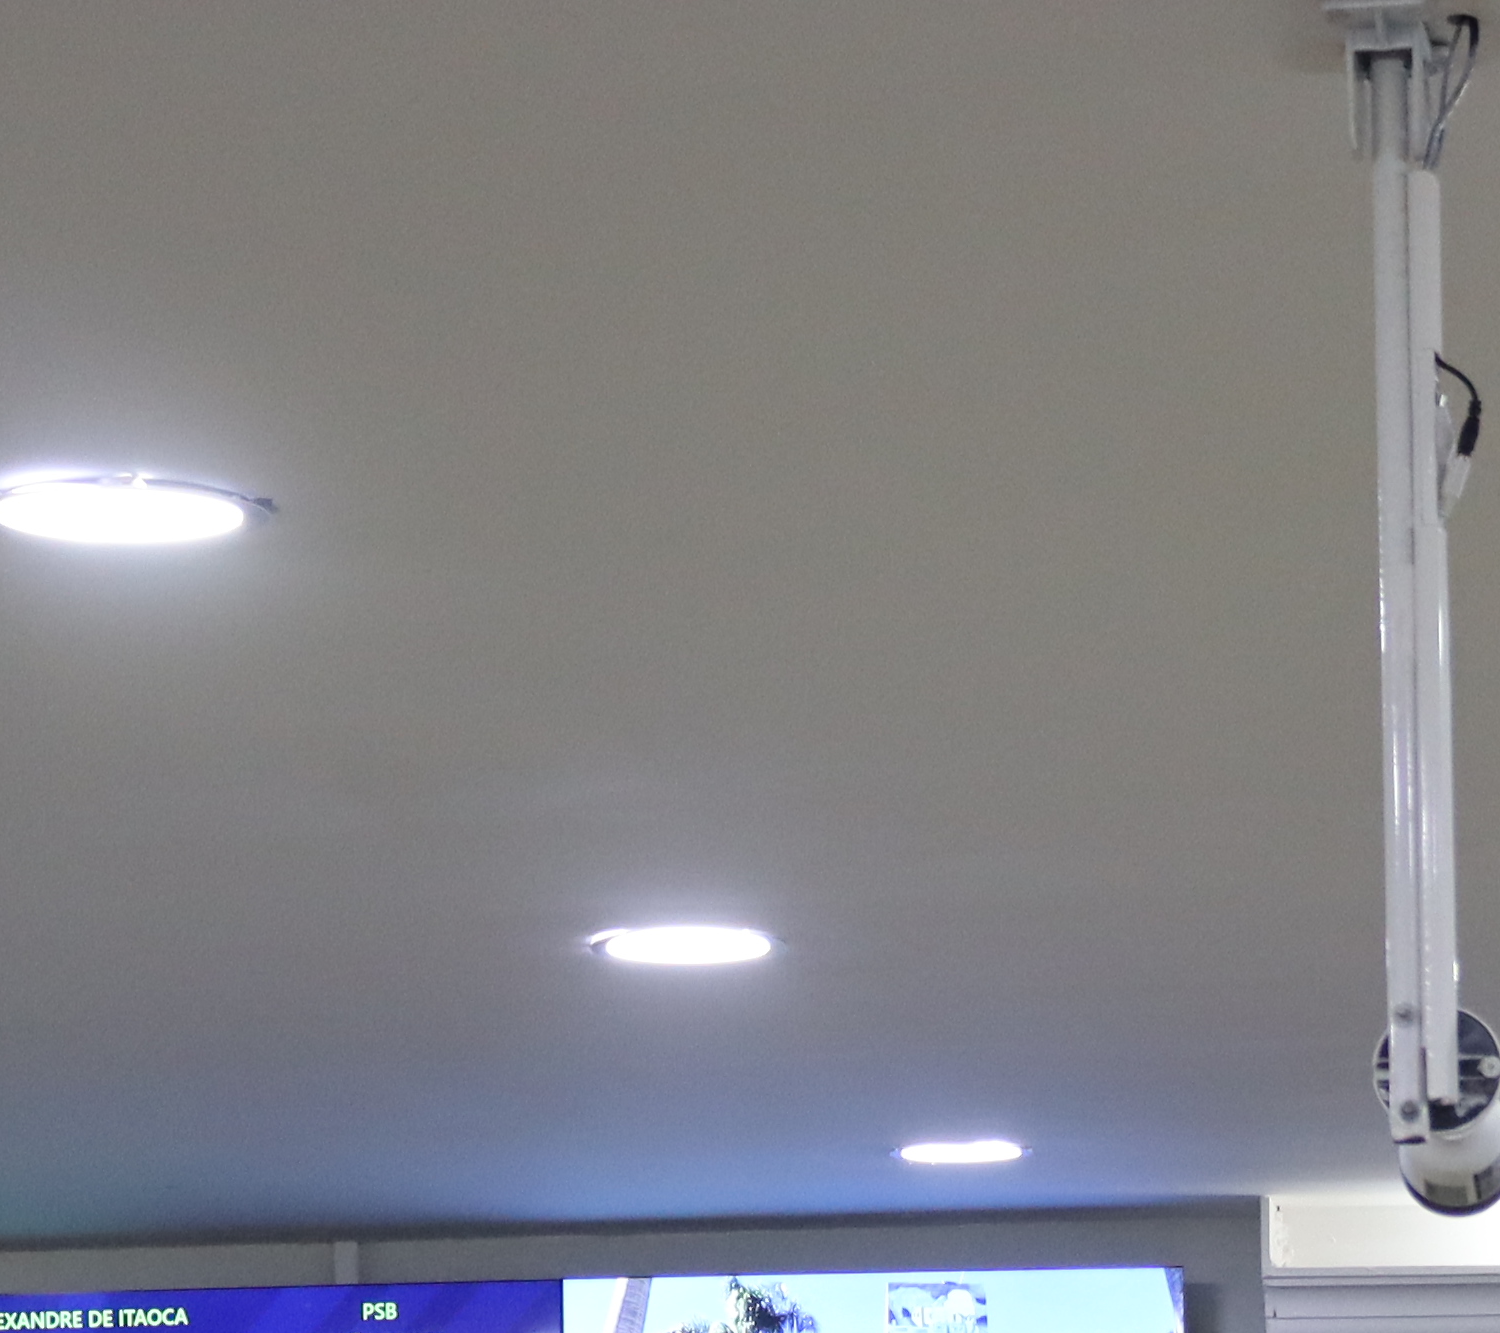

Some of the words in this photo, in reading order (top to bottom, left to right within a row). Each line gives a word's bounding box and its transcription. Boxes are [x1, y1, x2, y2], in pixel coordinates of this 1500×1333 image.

[89, 1310, 113, 1328] DE
[119, 1308, 188, 1326] ITAOCA
[363, 1303, 397, 1320] PSB
